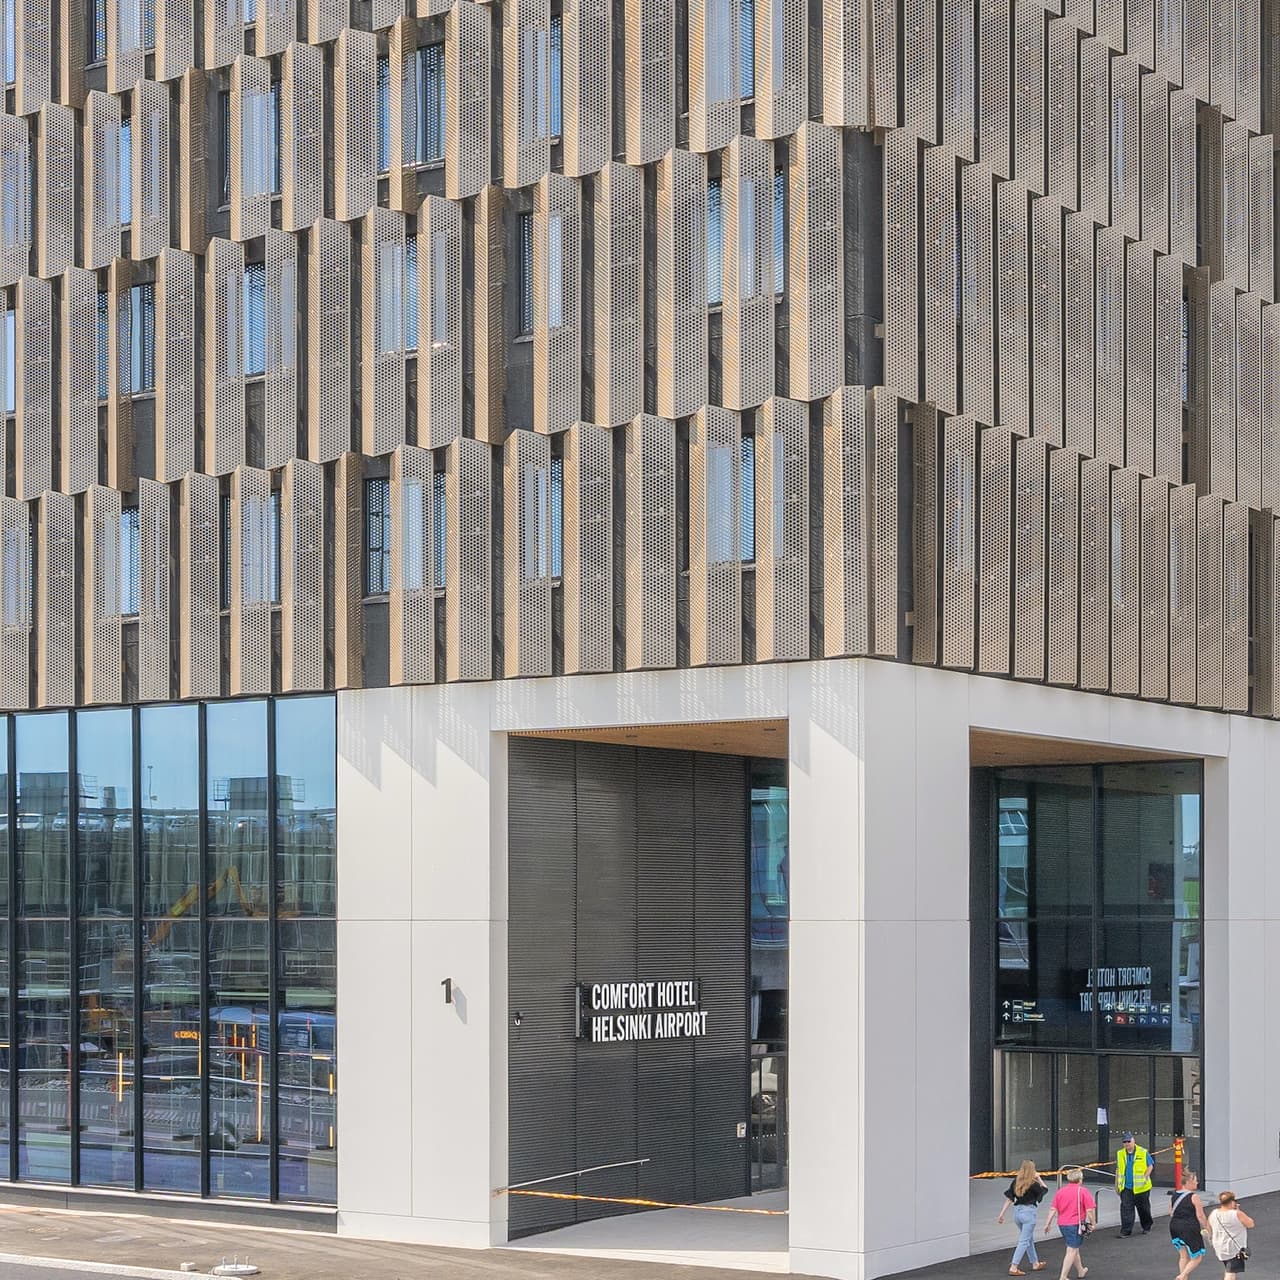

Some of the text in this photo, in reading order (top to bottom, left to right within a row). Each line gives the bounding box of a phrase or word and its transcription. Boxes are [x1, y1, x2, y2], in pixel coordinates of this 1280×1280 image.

[440, 977, 454, 1004] 1
[591, 981, 697, 1011] COMFORT HOTEL
[591, 1011, 709, 1043] HELSINKI AIRPORT
